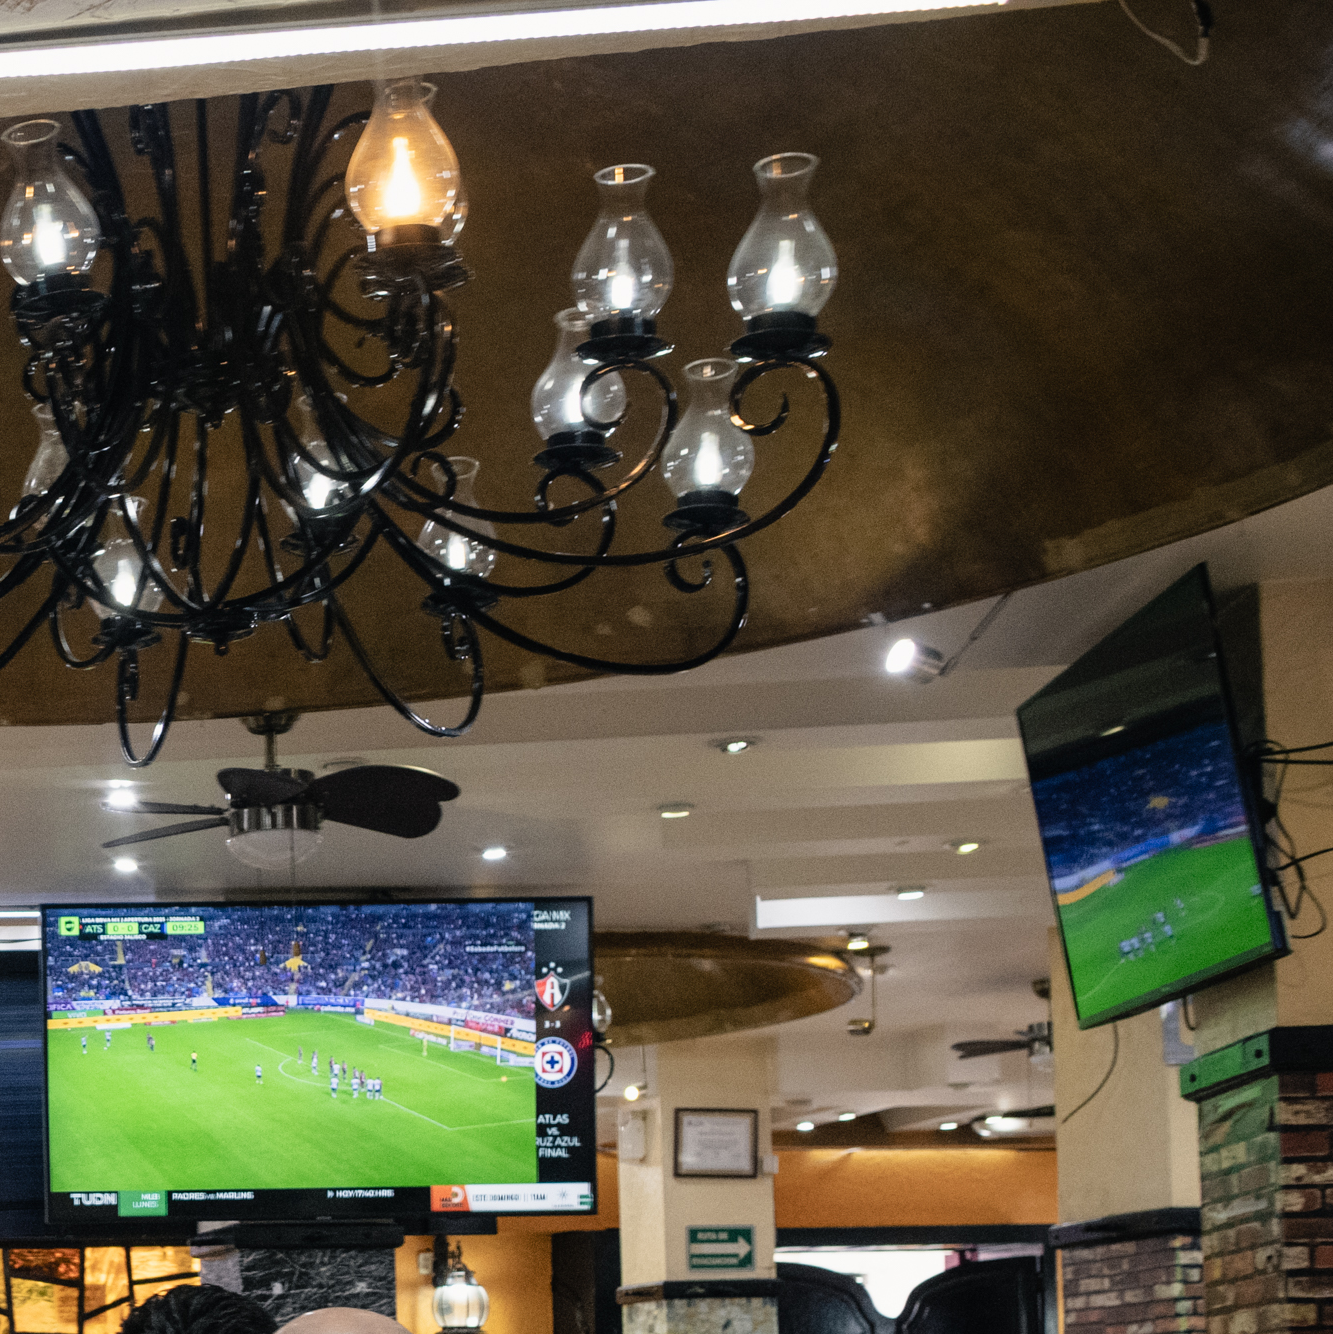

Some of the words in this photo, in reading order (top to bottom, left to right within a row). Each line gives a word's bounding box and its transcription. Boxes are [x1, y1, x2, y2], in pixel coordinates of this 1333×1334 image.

[84, 925, 103, 933] ATS
[141, 924, 161, 933] CAZ
[537, 1114, 569, 1125] ATLAS
[554, 1136, 581, 1147] AZUL
[538, 1148, 570, 1158] FINAL
[70, 1193, 118, 1206] TUDN
